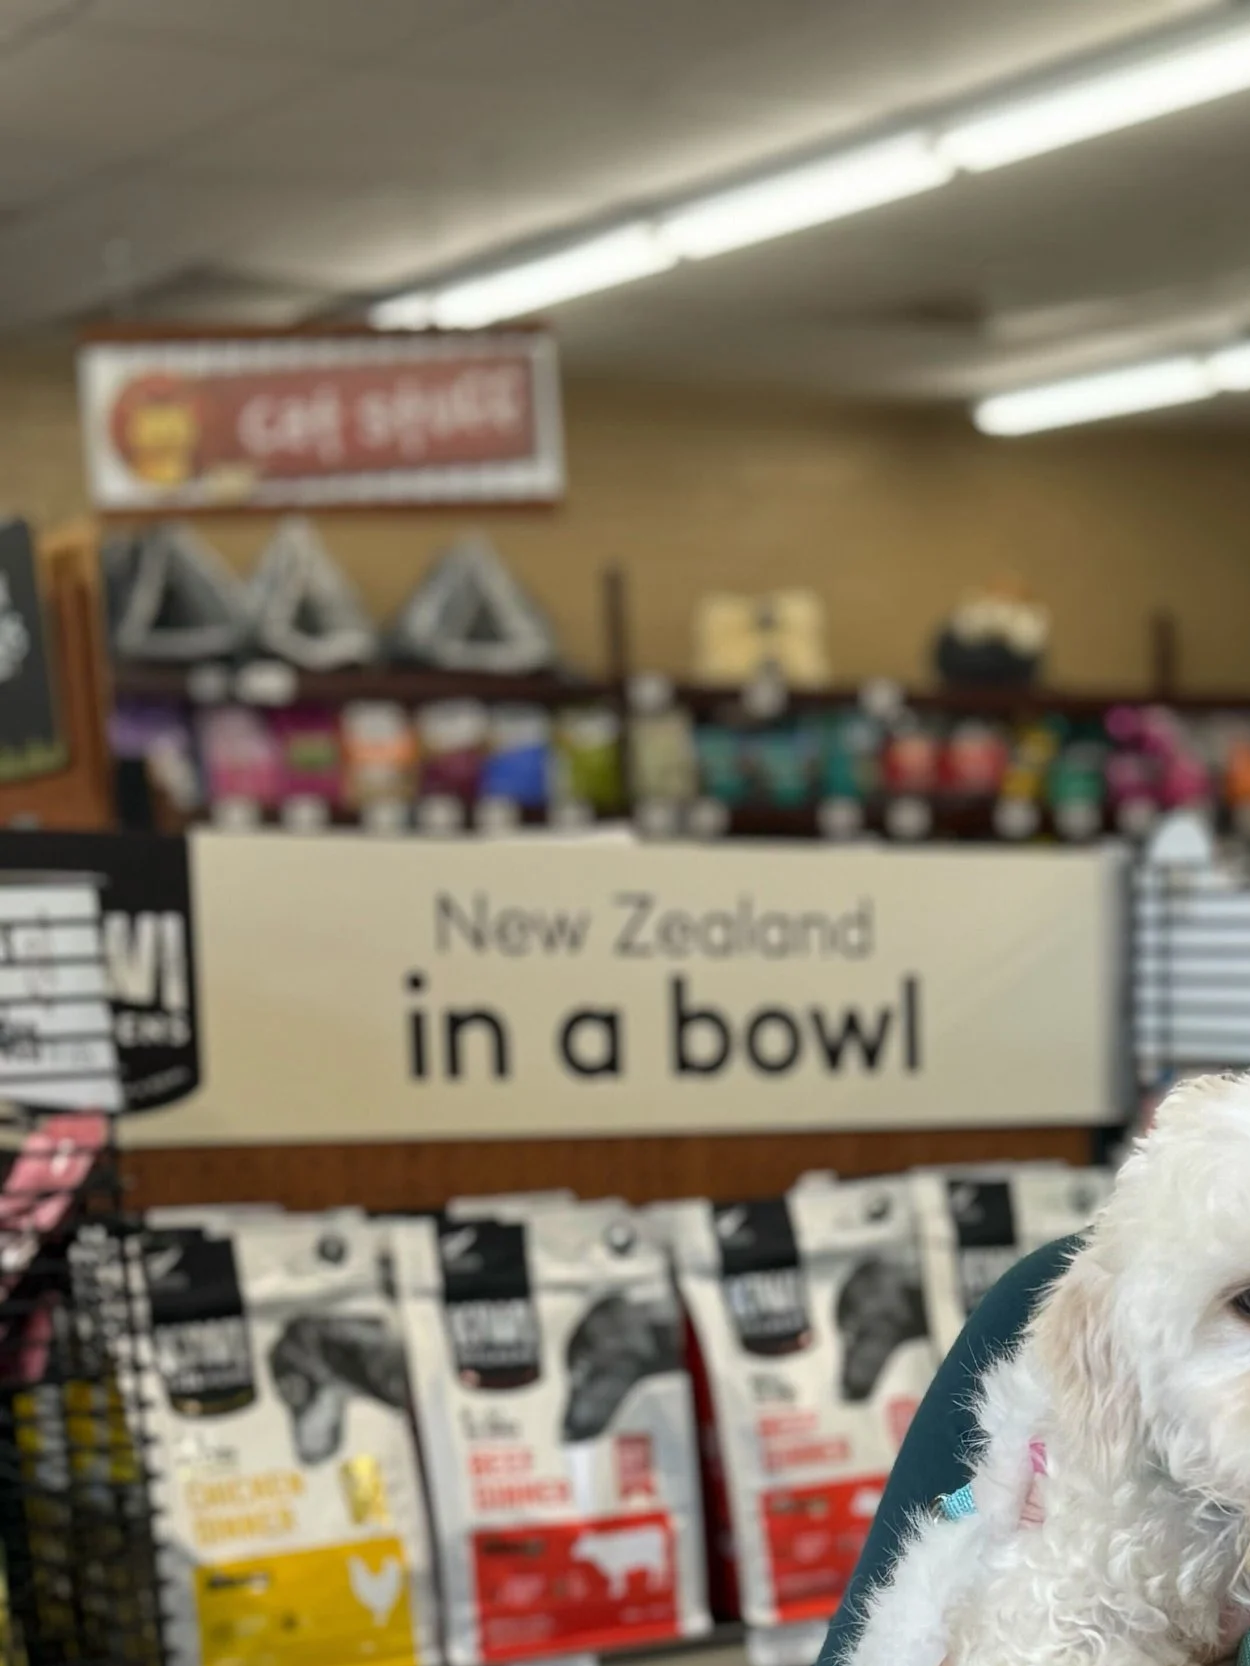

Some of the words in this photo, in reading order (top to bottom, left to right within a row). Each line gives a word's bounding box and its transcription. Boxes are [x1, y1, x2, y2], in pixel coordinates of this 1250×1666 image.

[433, 893, 592, 956] New
[612, 894, 874, 958] Zealand
[404, 968, 508, 1080] in
[557, 1006, 624, 1078] a
[671, 972, 921, 1078] bowl
